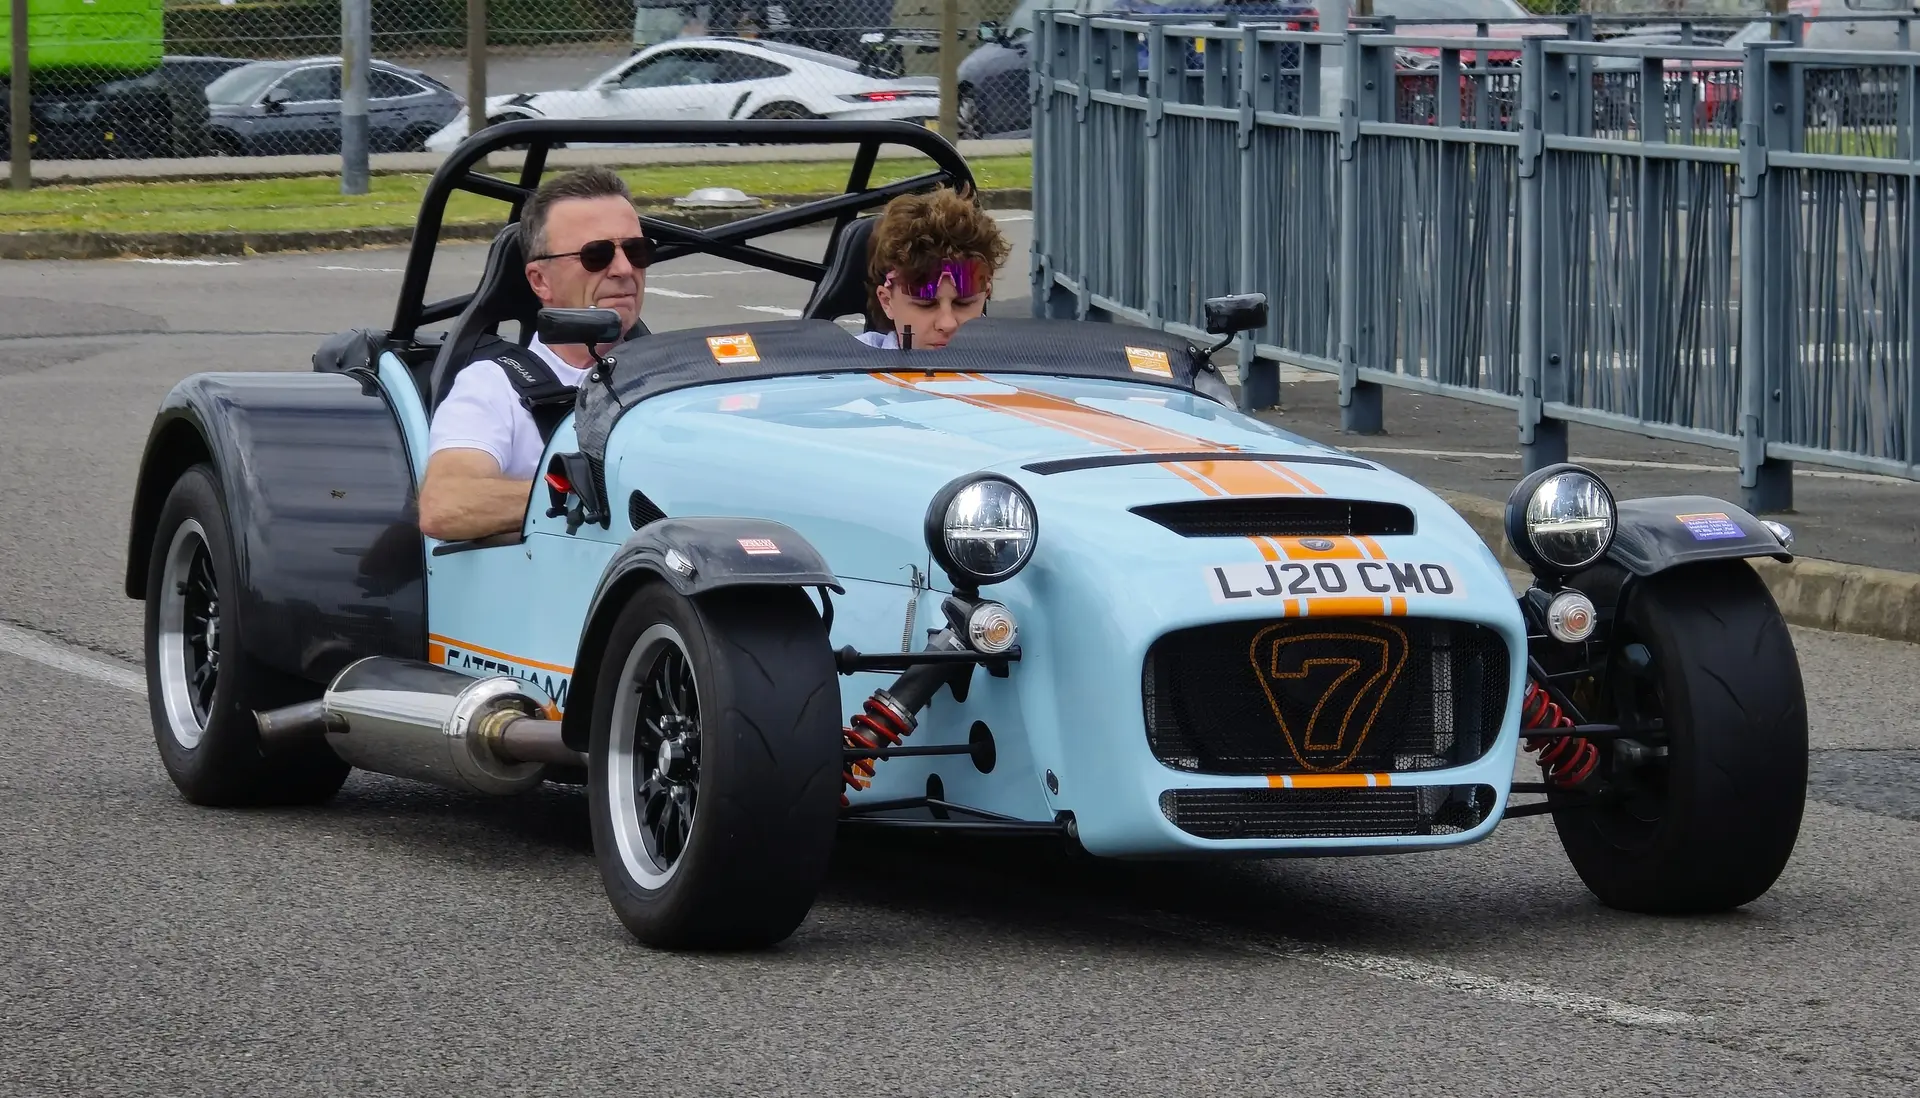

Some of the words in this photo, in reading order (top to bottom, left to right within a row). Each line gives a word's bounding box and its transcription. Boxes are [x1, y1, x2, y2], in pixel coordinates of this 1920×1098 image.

[1213, 562, 1348, 598] LJ20
[1356, 562, 1454, 594] CMO
[1271, 633, 1389, 751] 7
